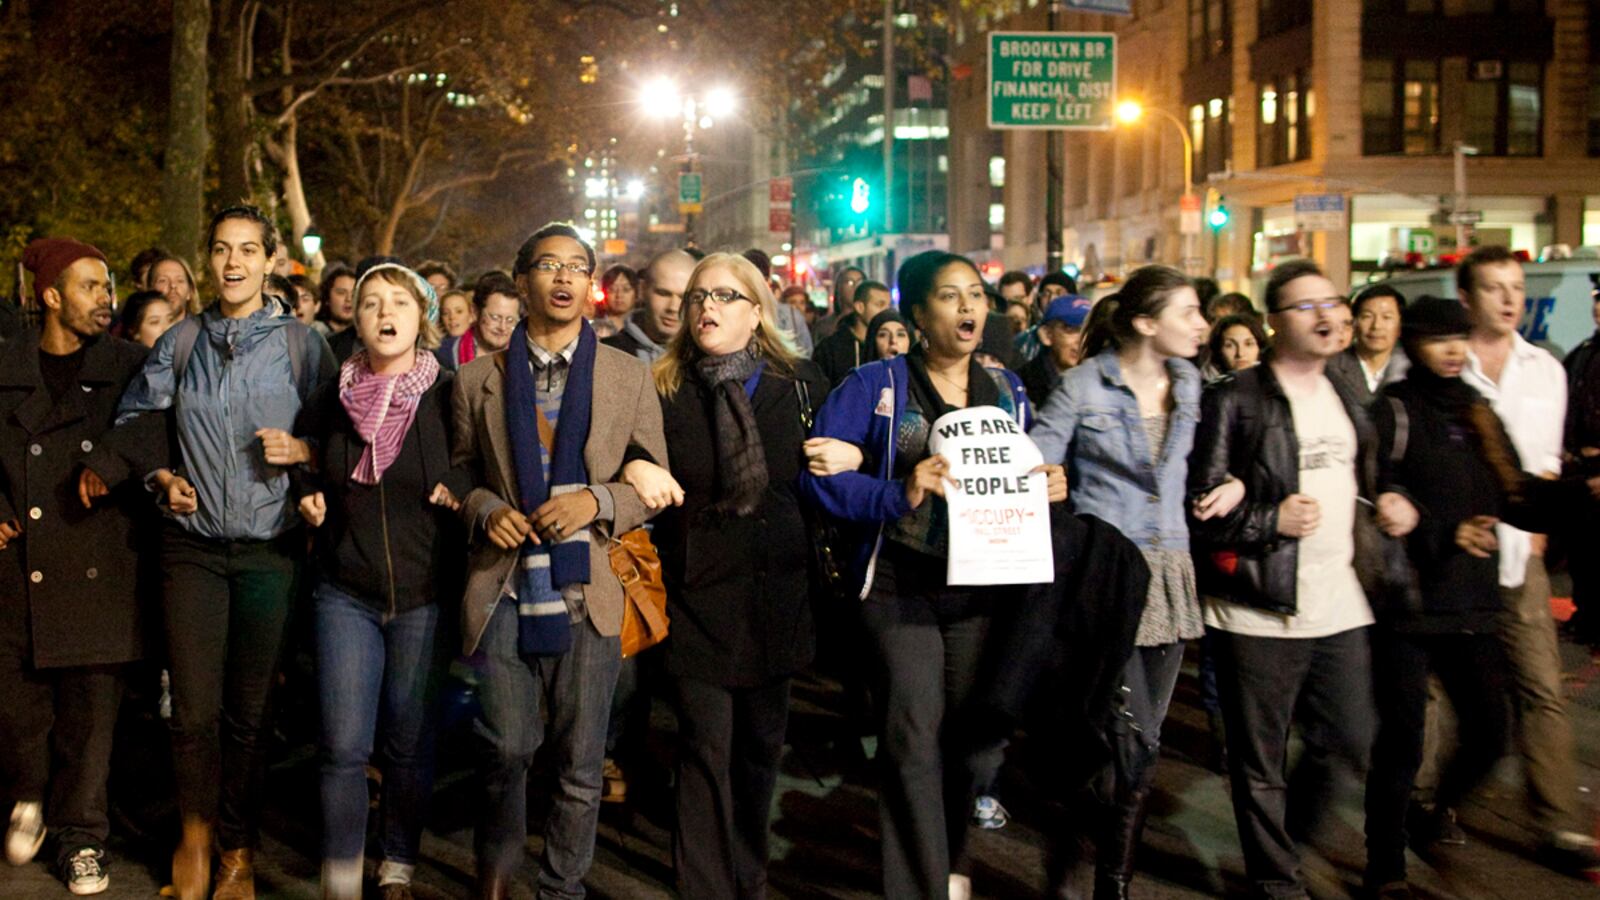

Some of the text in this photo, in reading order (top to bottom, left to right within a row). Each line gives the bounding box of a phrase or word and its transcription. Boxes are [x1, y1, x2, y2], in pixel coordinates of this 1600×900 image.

[1000, 41, 1106, 58] BROOKLYN BR
[1012, 61, 1093, 78] FDR DRIVE
[994, 81, 1111, 99] FINANCIAL DIST
[1011, 103, 1093, 120] KEEP LEFT
[938, 419, 1019, 439] WE ARE
[961, 446, 1011, 464] FREE
